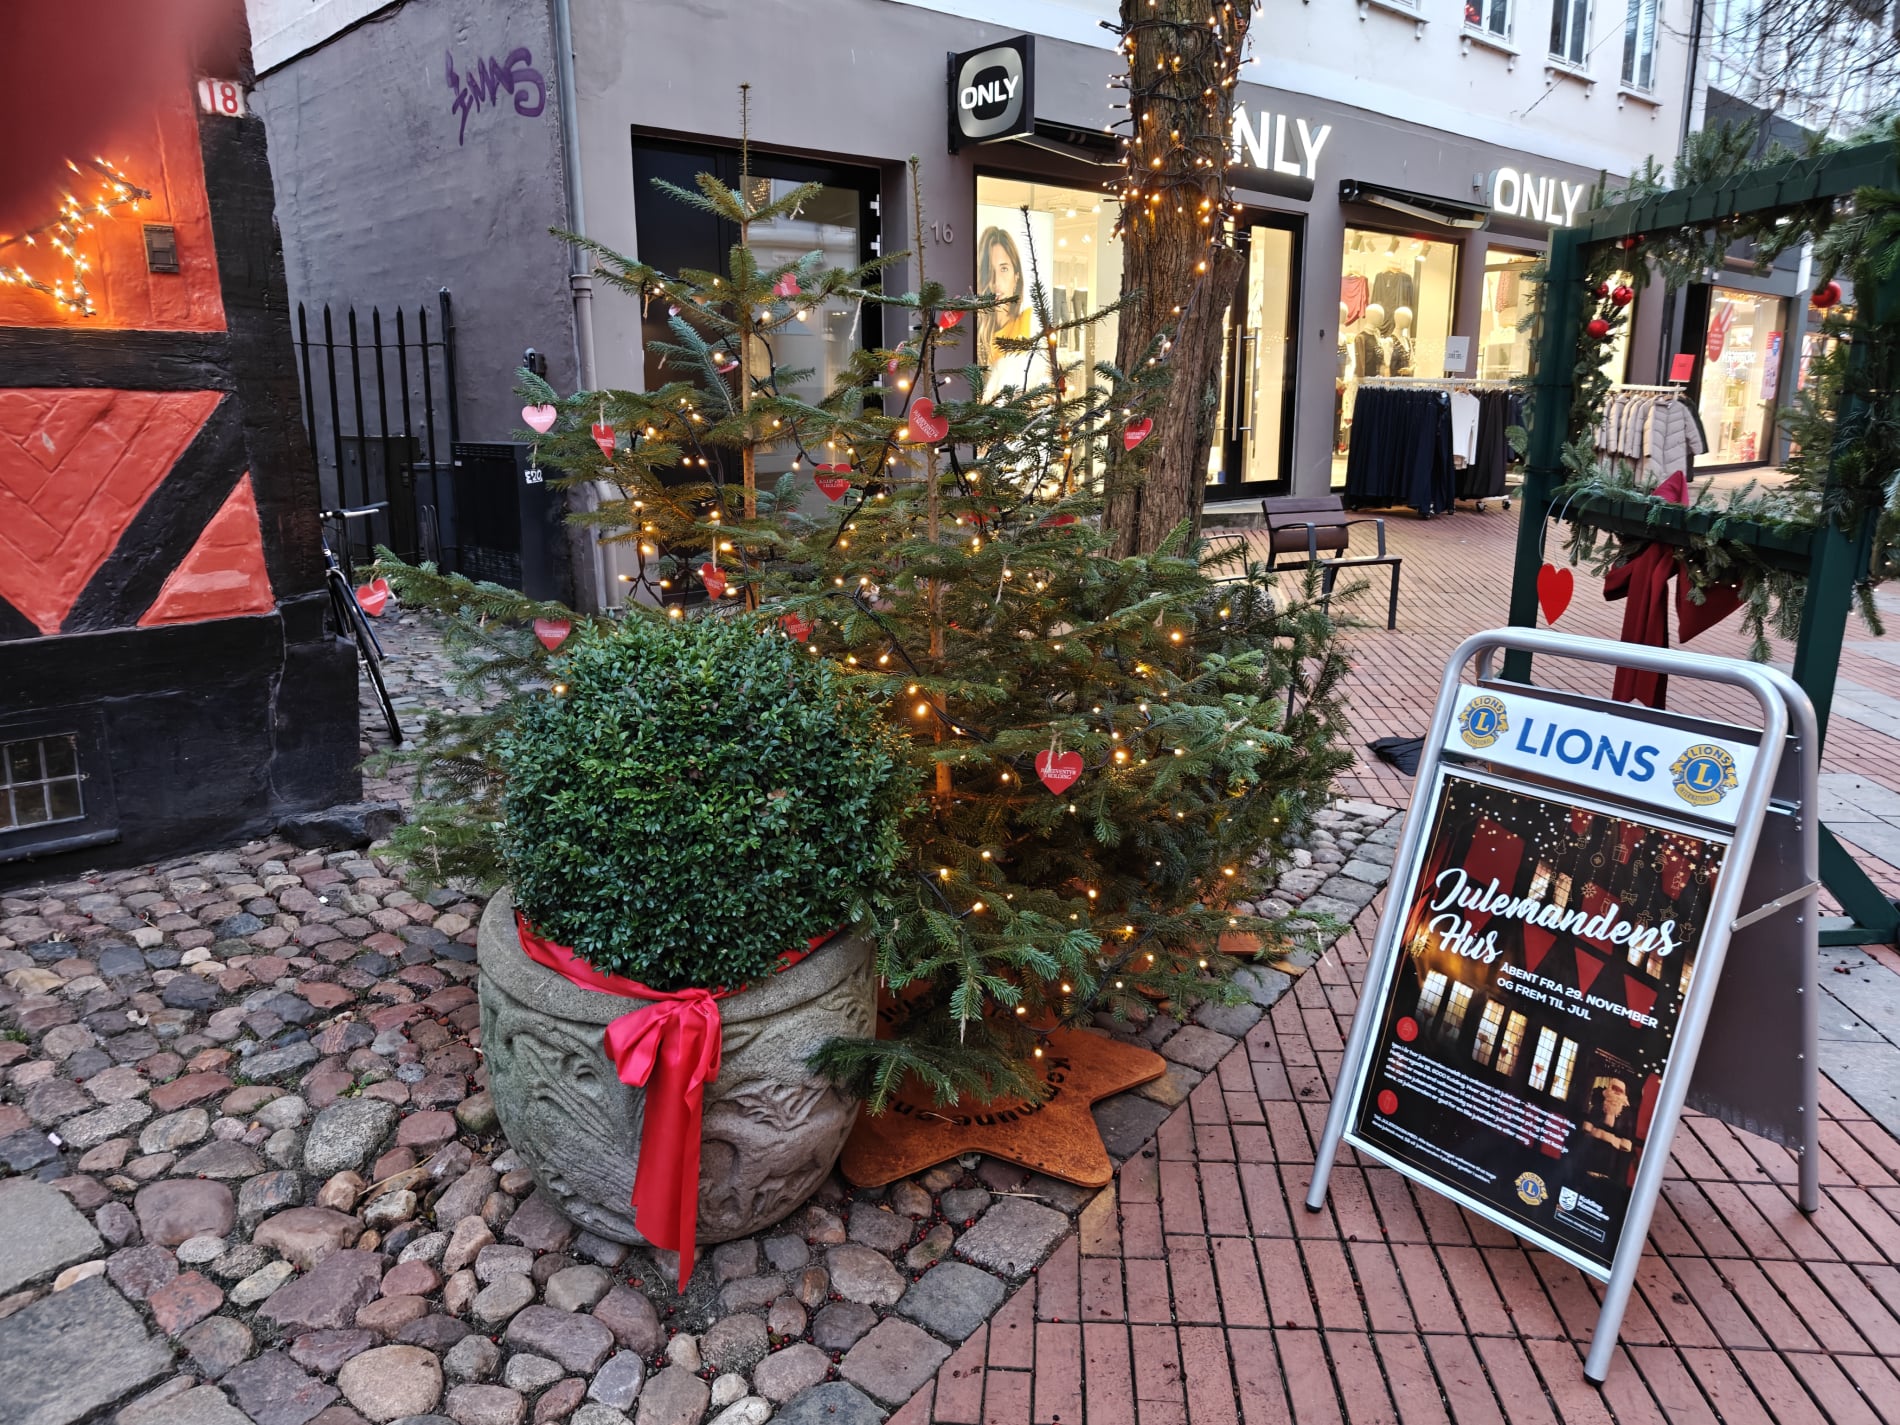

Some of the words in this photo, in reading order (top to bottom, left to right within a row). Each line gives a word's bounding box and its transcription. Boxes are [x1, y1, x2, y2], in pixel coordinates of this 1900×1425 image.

[207, 80, 239, 114] 18
[960, 75, 1019, 110] ONLY
[1232, 103, 1332, 180] NLY
[1493, 167, 1585, 227] ONLY
[930, 220, 954, 244] 16
[1471, 694, 1506, 713] LIONS
[1475, 711, 1490, 732] L
[1516, 717, 1660, 782] LIONS
[1688, 744, 1733, 765] LIONS
[1696, 763, 1714, 787] L
[1430, 867, 1683, 957] Julemandens
[1428, 913, 1504, 964] Hus
[1496, 977, 1514, 990] OG
[1514, 984, 1547, 1003] FREM
[1548, 995, 1566, 1011] TIL
[1567, 1004, 1592, 1021] JUL
[1500, 962, 1539, 984] ÅBENT
[1539, 977, 1564, 995] FRA
[1564, 987, 1584, 1002] 29.
[1585, 993, 1659, 1029] NOVEMBER
